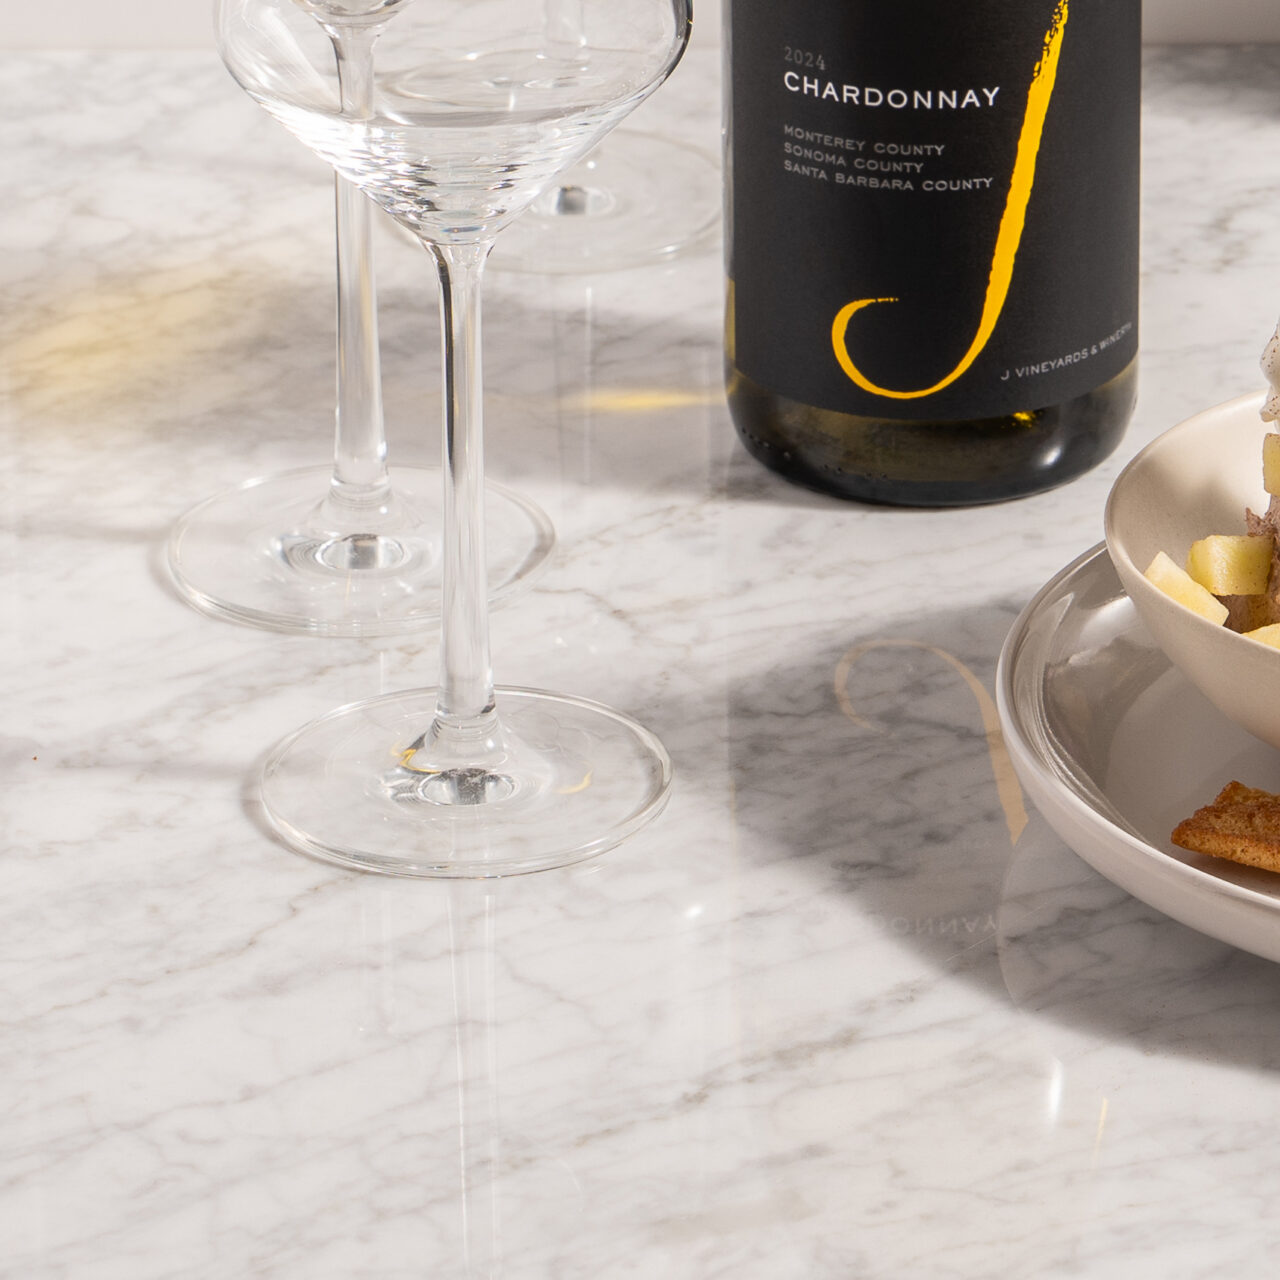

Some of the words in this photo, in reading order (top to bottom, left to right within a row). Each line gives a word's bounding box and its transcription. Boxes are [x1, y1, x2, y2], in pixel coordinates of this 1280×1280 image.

[784, 46, 826, 71] 2024
[783, 71, 1000, 110] CHARDONNAY
[784, 124, 866, 151] MONTEREY
[873, 142, 945, 156] COUNTY
[784, 142, 847, 167] SONOMA
[854, 158, 924, 174] COUNTY
[784, 160, 828, 181] SANTA
[834, 172, 915, 191] BARBARA
[922, 177, 993, 191] COUNTY
[1000, 369, 1010, 381] J
[1015, 348, 1088, 378] VINEYARDS
[1090, 344, 1098, 356] &
